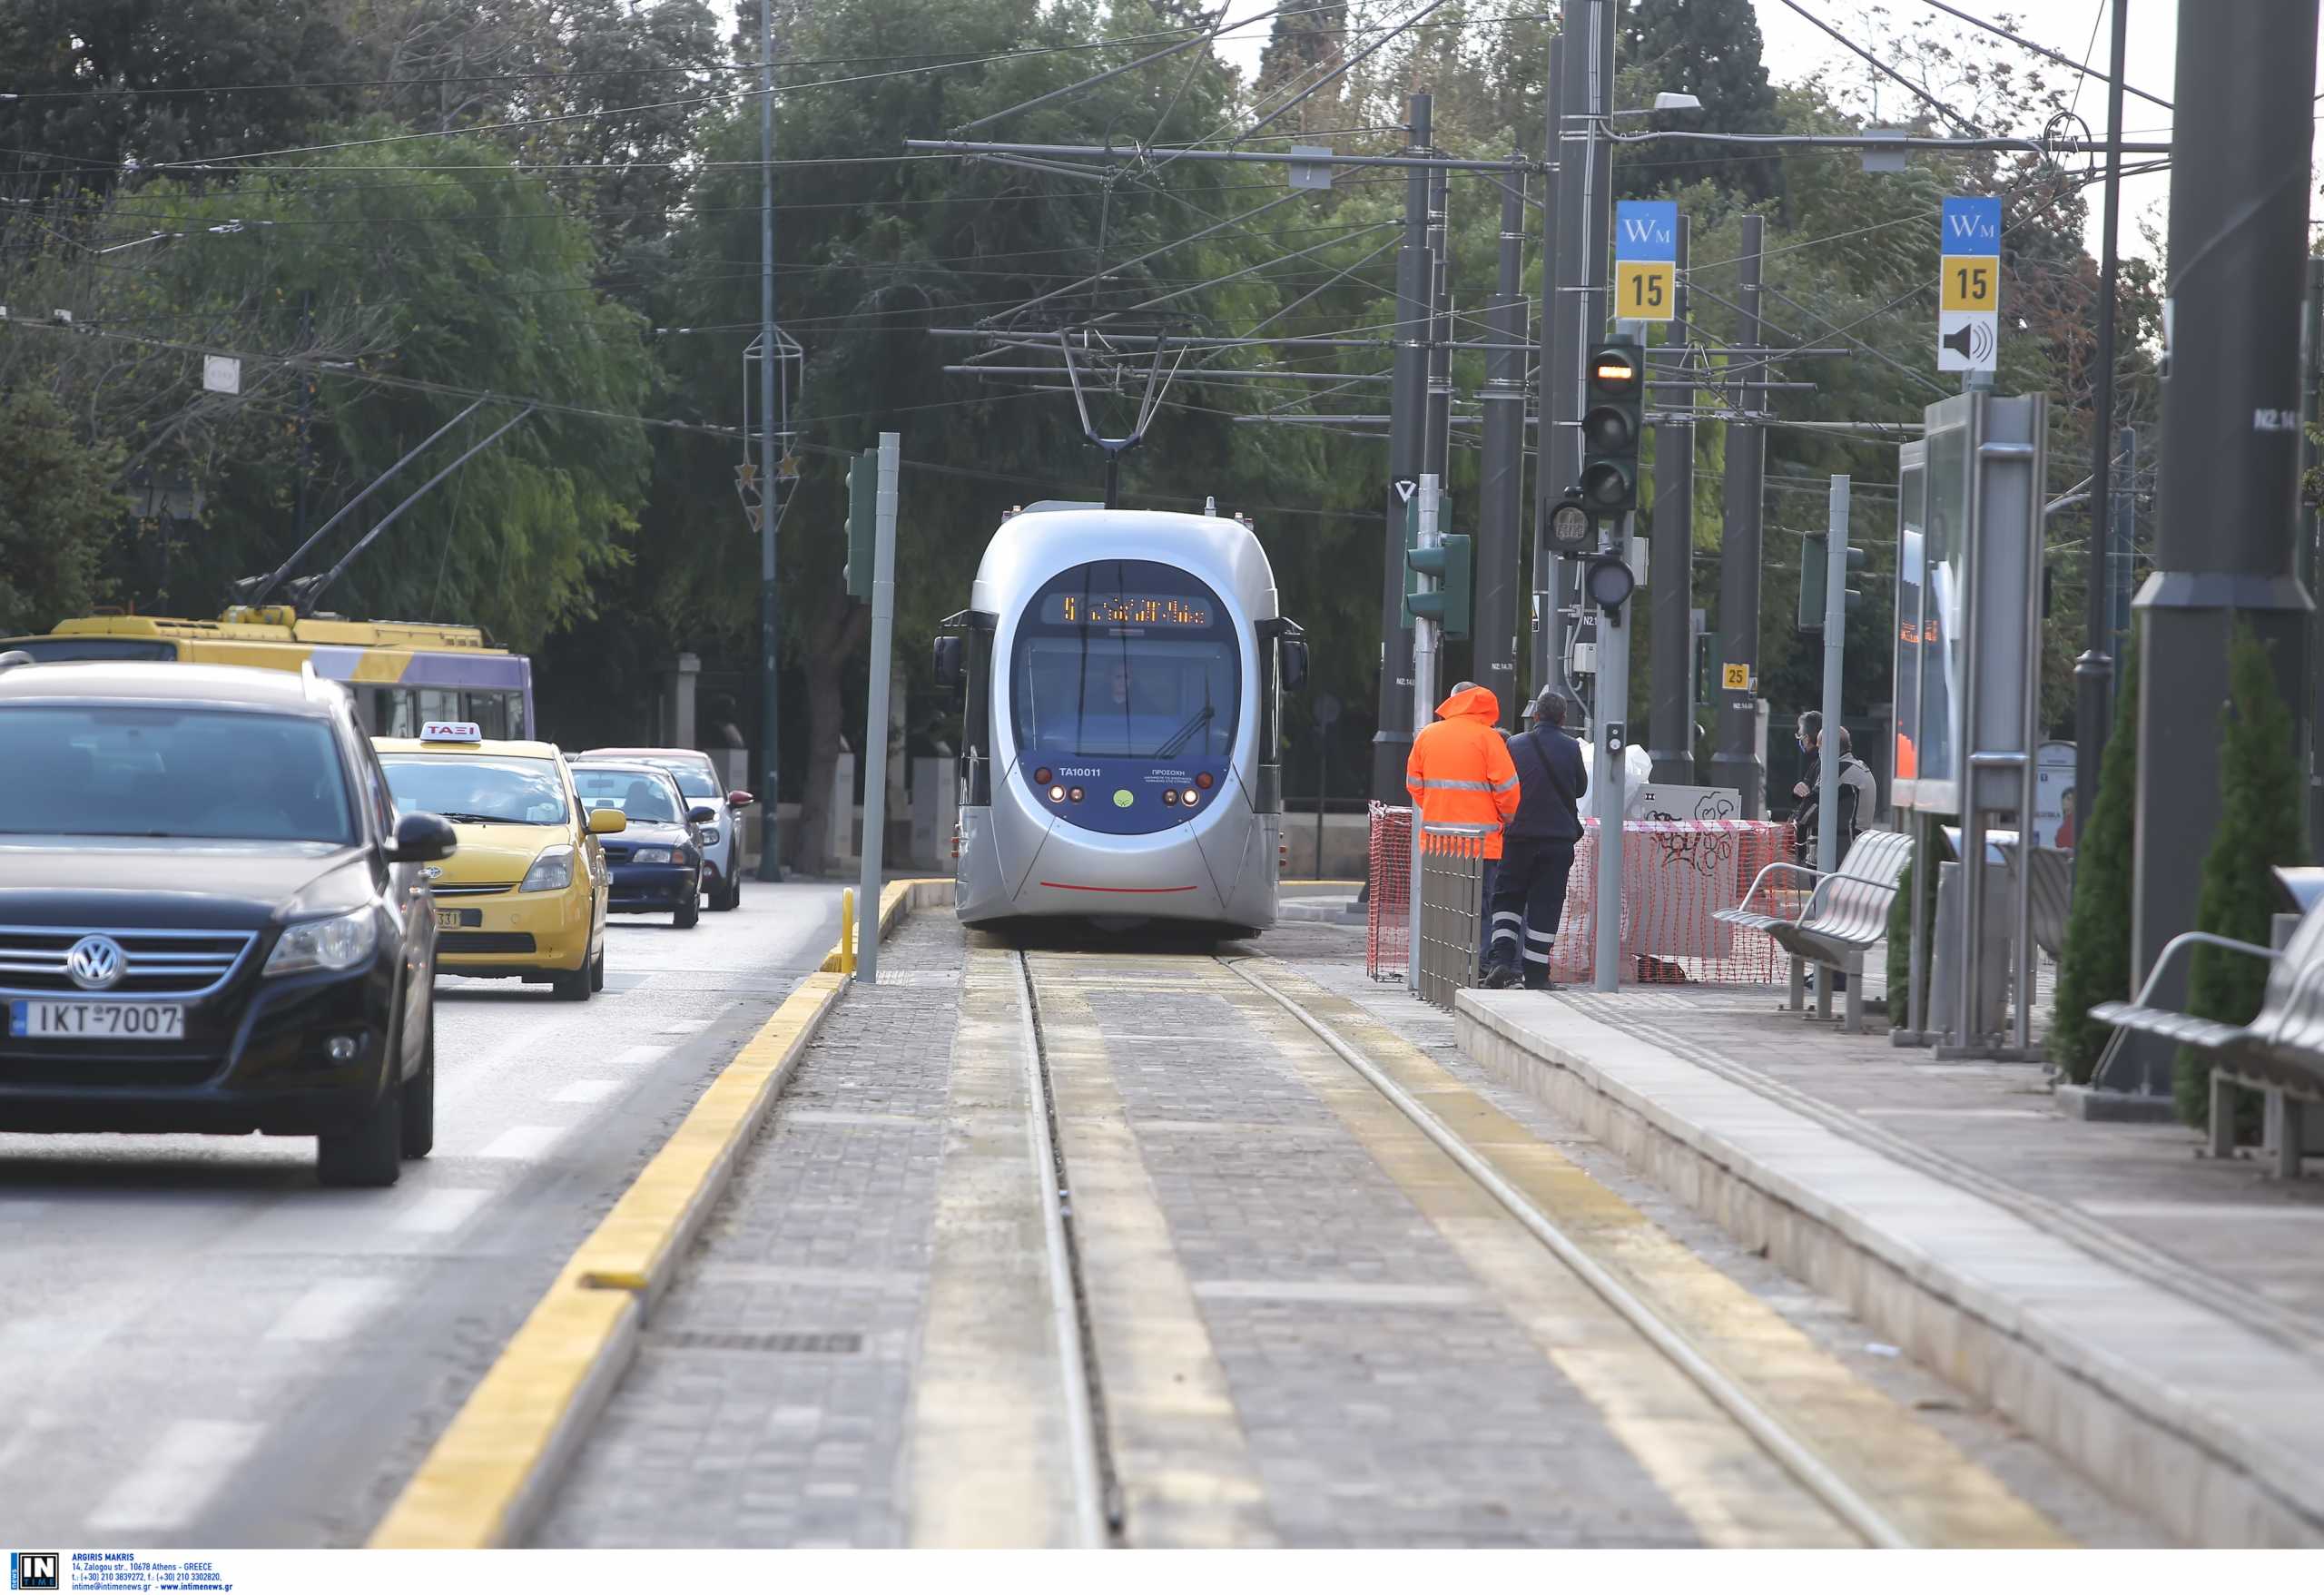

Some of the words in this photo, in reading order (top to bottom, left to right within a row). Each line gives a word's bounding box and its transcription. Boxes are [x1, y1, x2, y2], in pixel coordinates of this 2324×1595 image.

[1633, 275, 1662, 306] 15
[1957, 268, 1986, 300] 15
[1728, 669, 1743, 683] 25
[428, 725, 475, 735] ΤΑΞΙ
[1059, 767, 1101, 777] TA10011
